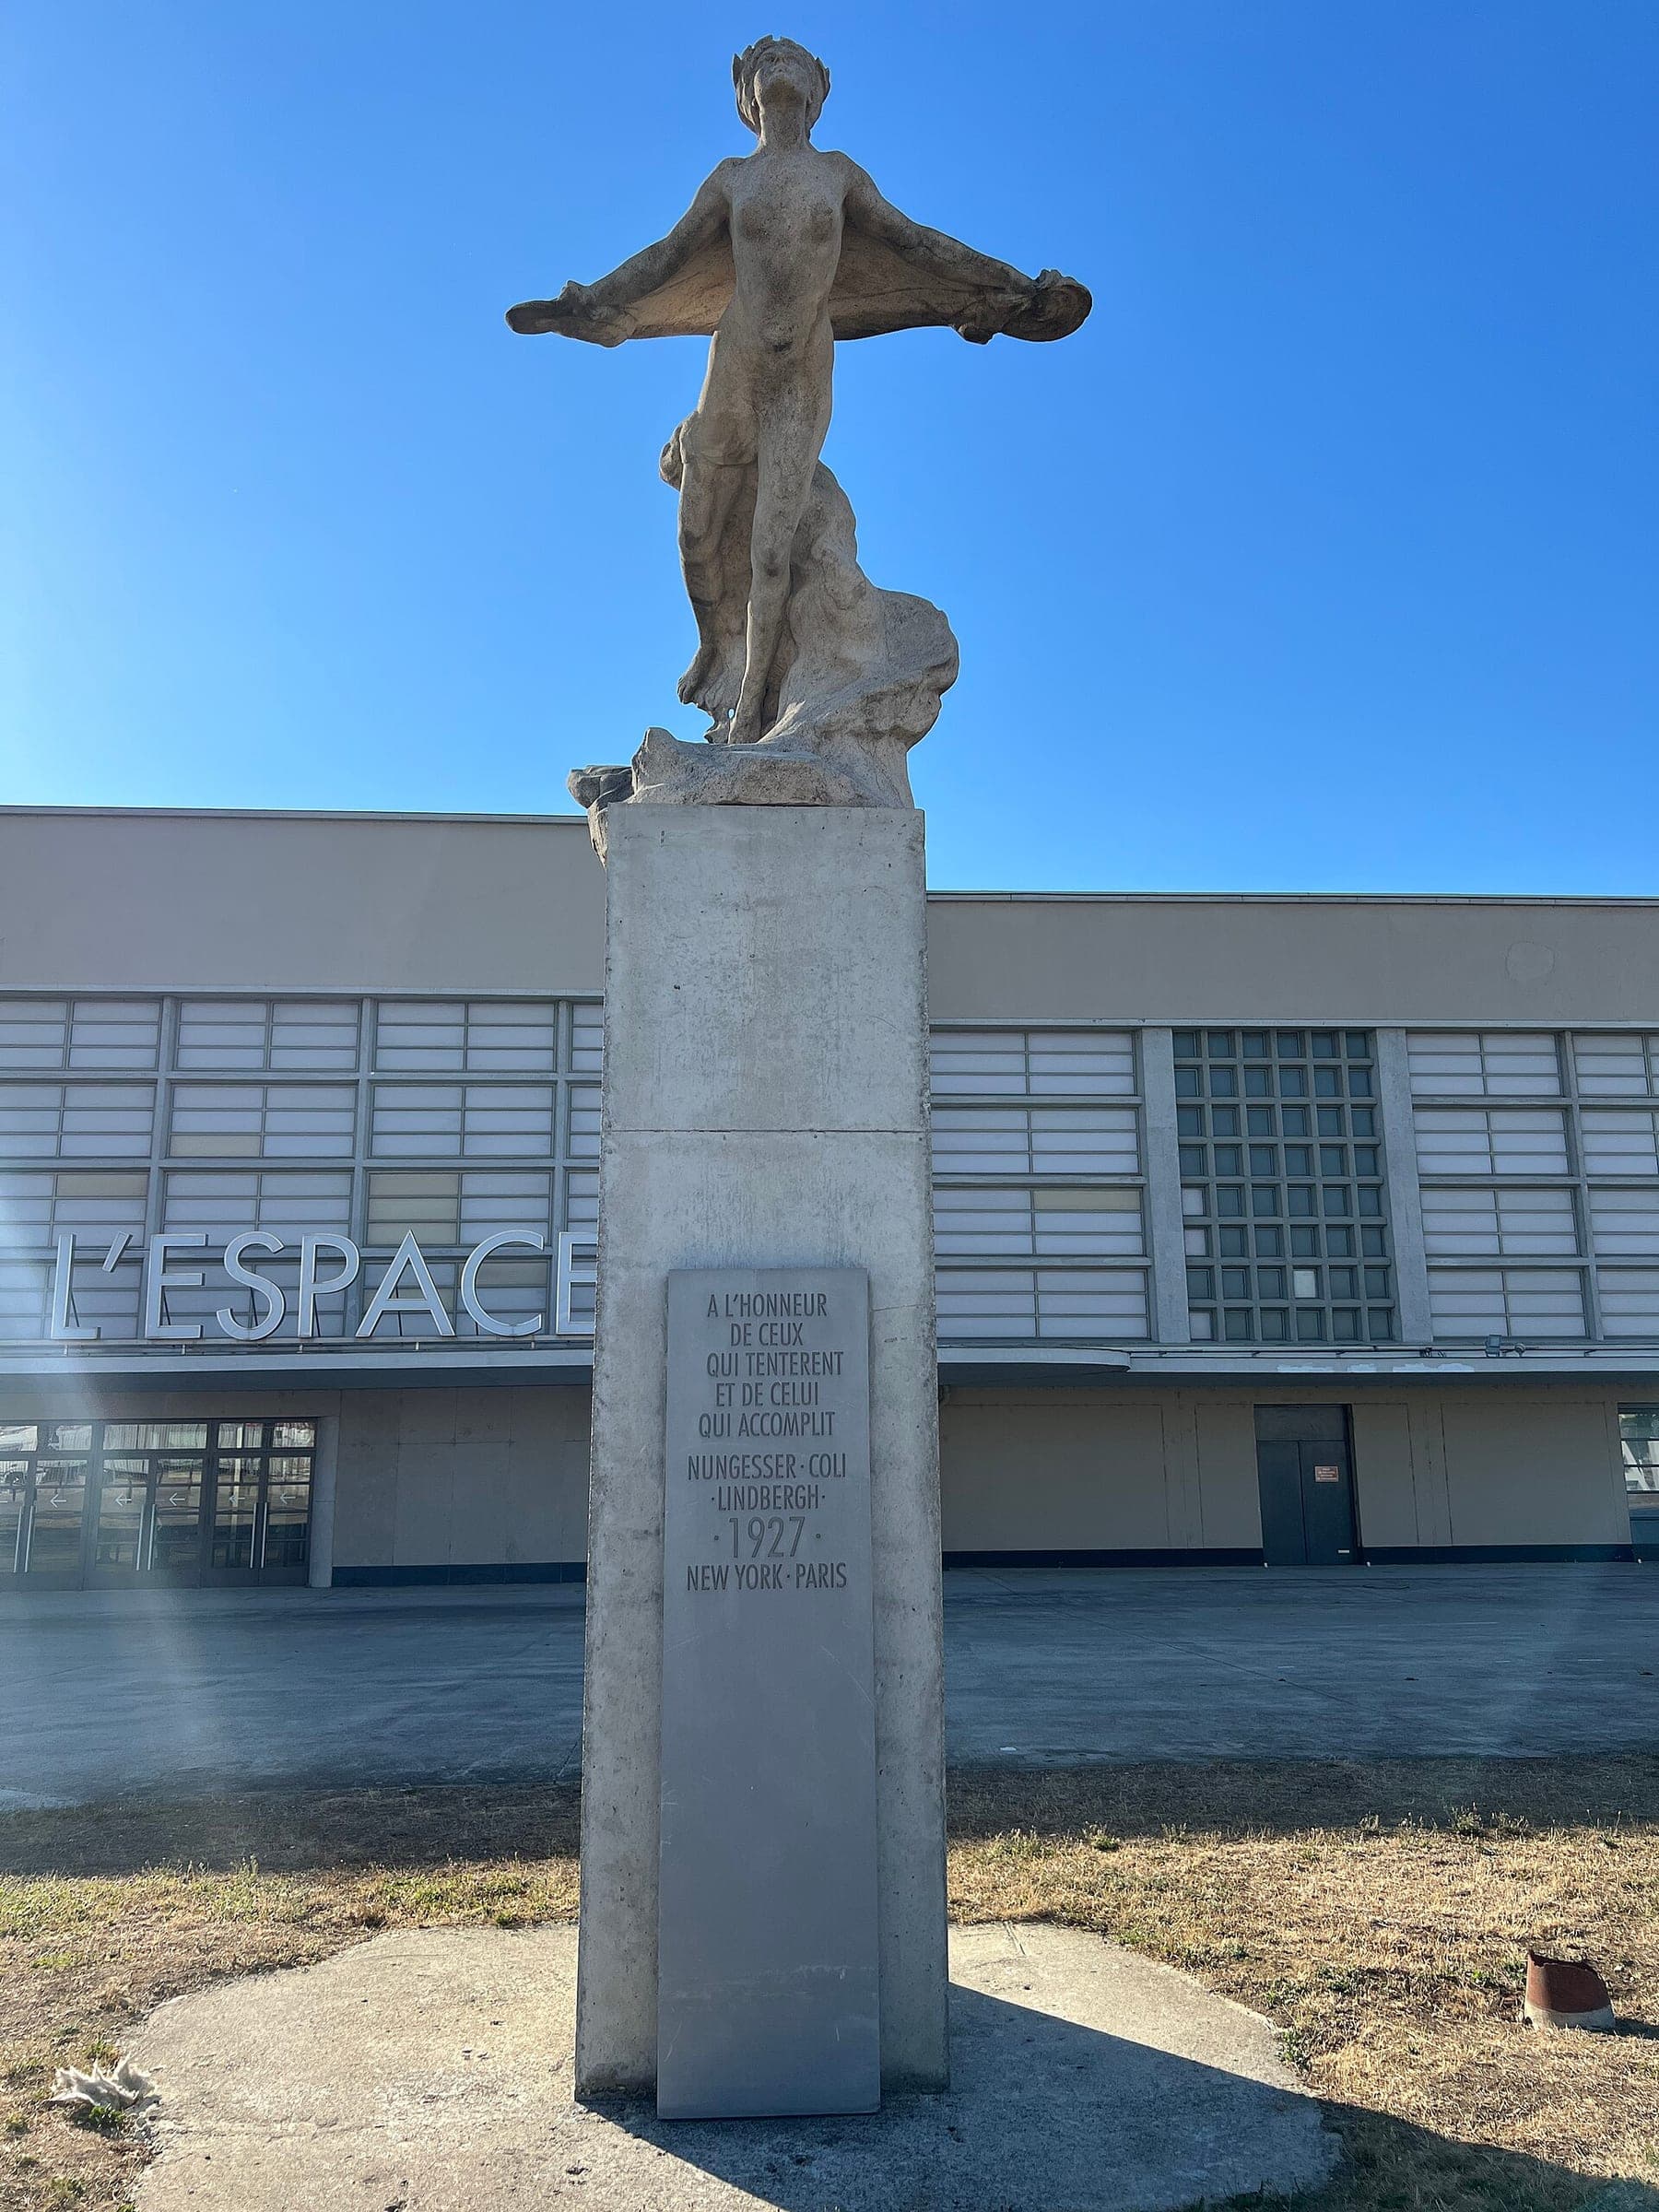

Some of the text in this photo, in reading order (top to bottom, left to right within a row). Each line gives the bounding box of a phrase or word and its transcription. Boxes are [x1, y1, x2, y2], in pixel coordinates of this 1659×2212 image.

[51, 1229, 597, 1340] L'ESPACE
[707, 1293, 828, 1318] A L'HONNEUR
[731, 1322, 804, 1347] DE CEUX
[707, 1351, 844, 1378] QUI TENTERENT
[716, 1381, 818, 1407] ET DE CELUI
[699, 1411, 836, 1439] QUI ACCOMPLIT
[728, 1516, 806, 1559] 1927
[687, 1562, 848, 1591] NEW YORK PARIS
